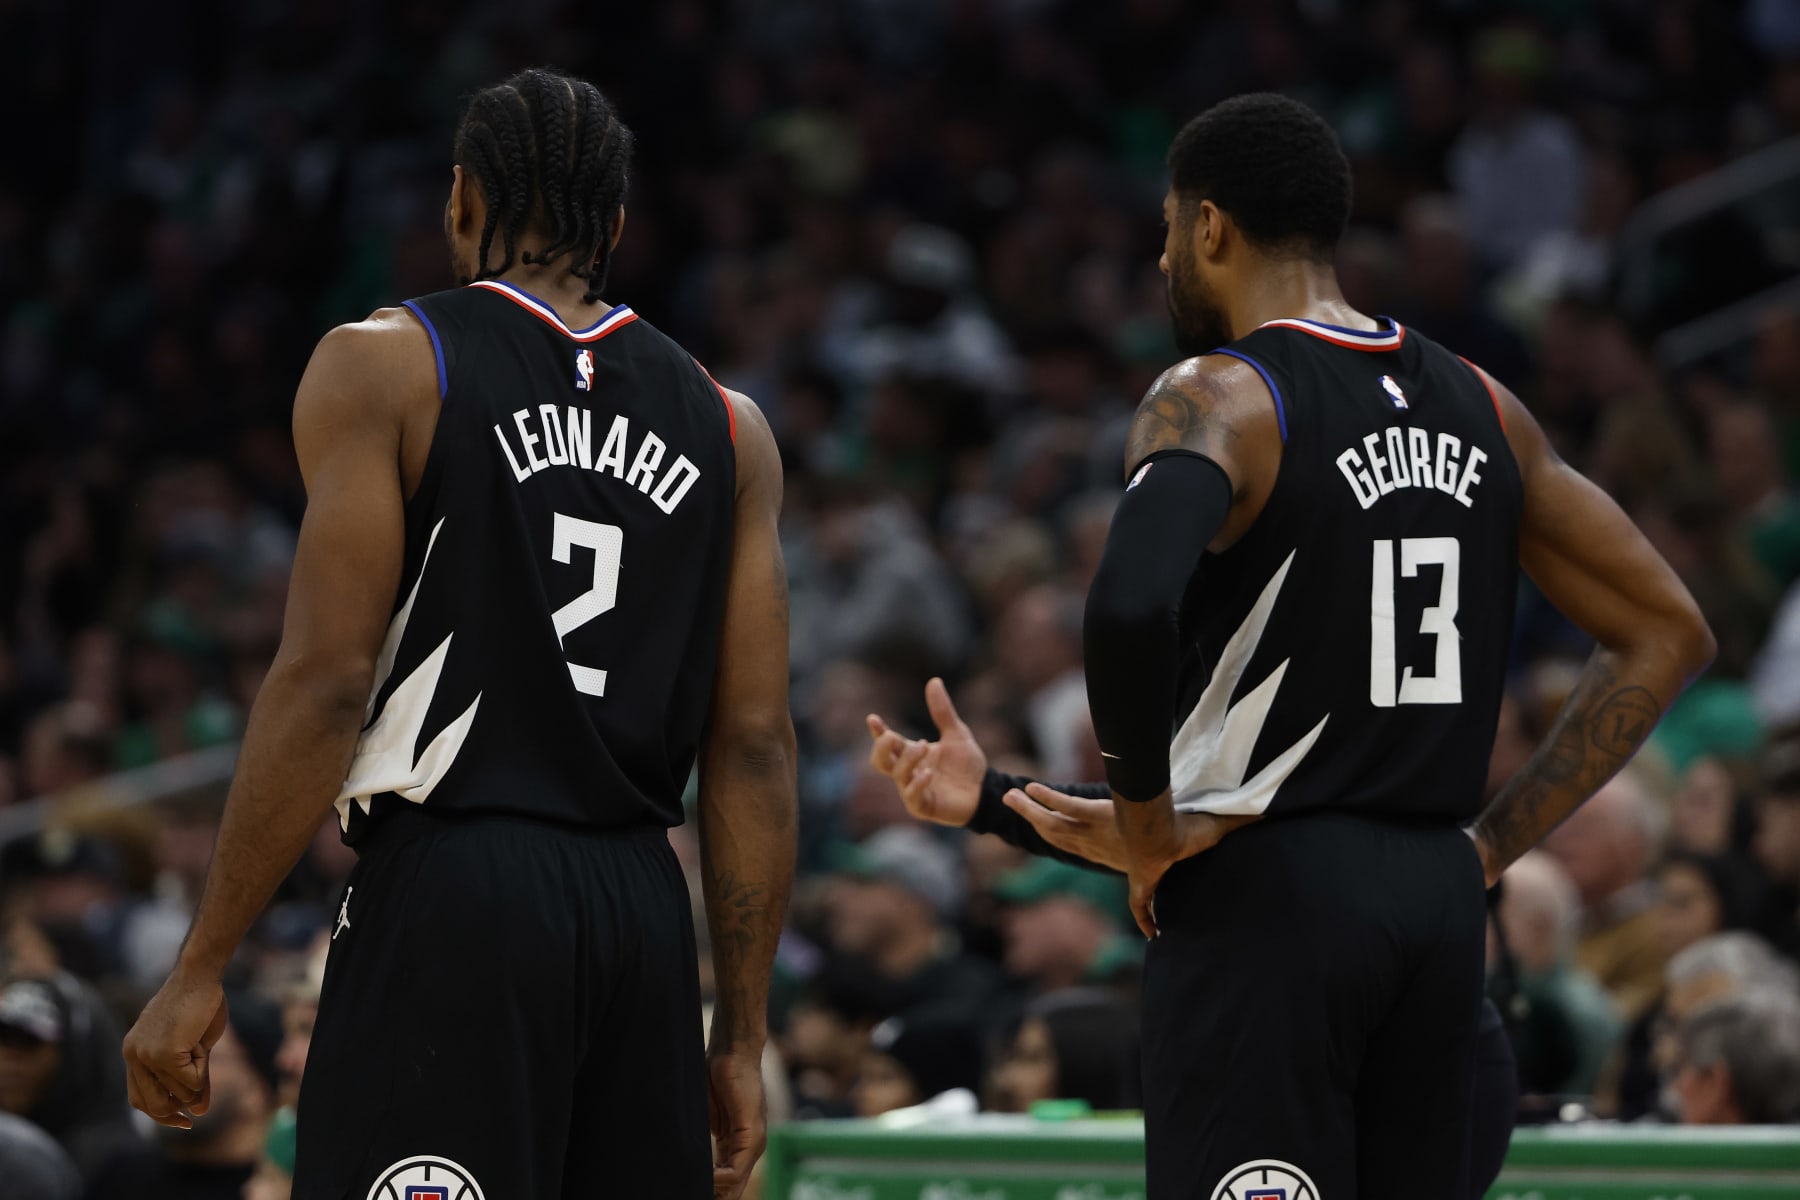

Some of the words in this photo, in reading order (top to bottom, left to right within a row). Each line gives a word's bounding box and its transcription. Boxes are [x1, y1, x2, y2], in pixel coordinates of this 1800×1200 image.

[494, 403, 701, 515] LEONARD
[1336, 426, 1488, 510] GEORGE
[551, 511, 624, 698] 2
[1370, 536, 1463, 708] 13
